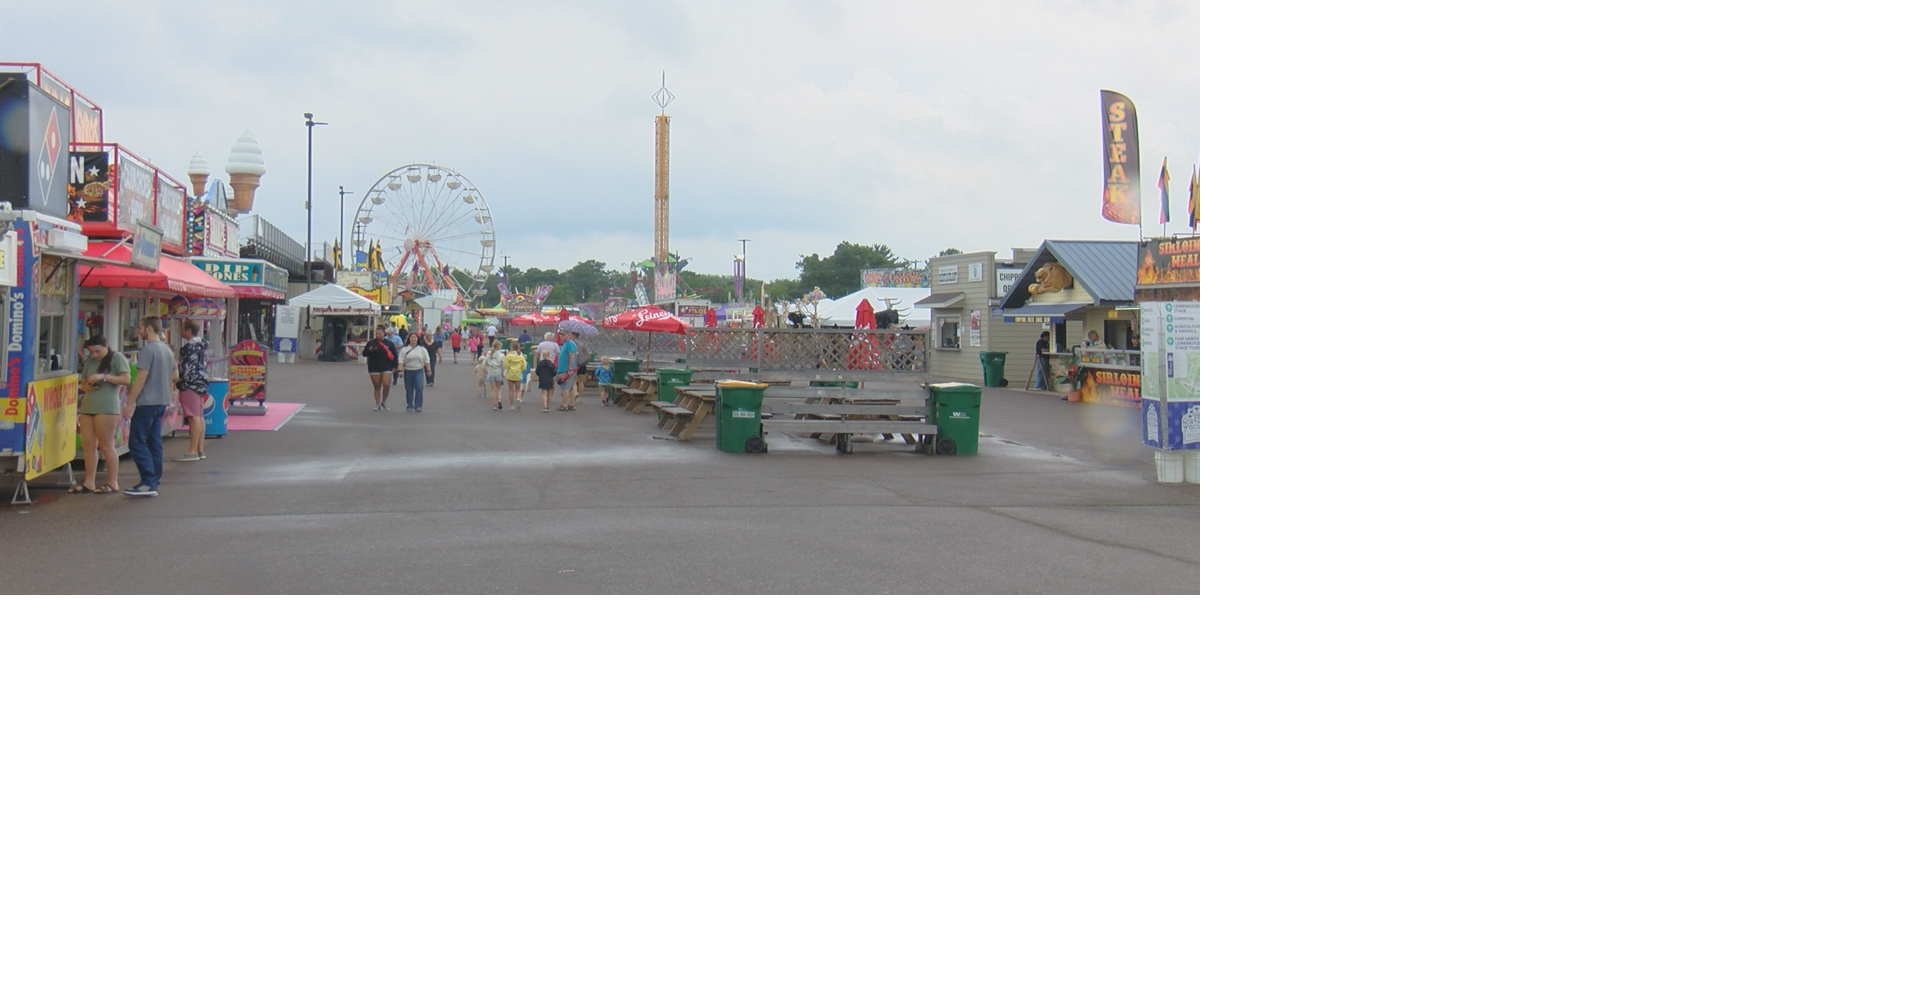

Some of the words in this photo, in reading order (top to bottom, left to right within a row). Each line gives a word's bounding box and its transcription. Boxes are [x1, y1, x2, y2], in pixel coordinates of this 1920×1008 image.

[1108, 102, 1129, 202] STEAK
[1159, 240, 1200, 255] SIRLOIN
[205, 263, 249, 272] DIP
[206, 272, 249, 281] ONES
[1000, 273, 1020, 282] CHIPP
[8, 292, 24, 351] Domino's
[4, 357, 21, 416] Domino's
[1095, 370, 1141, 387] SIRLOIN
